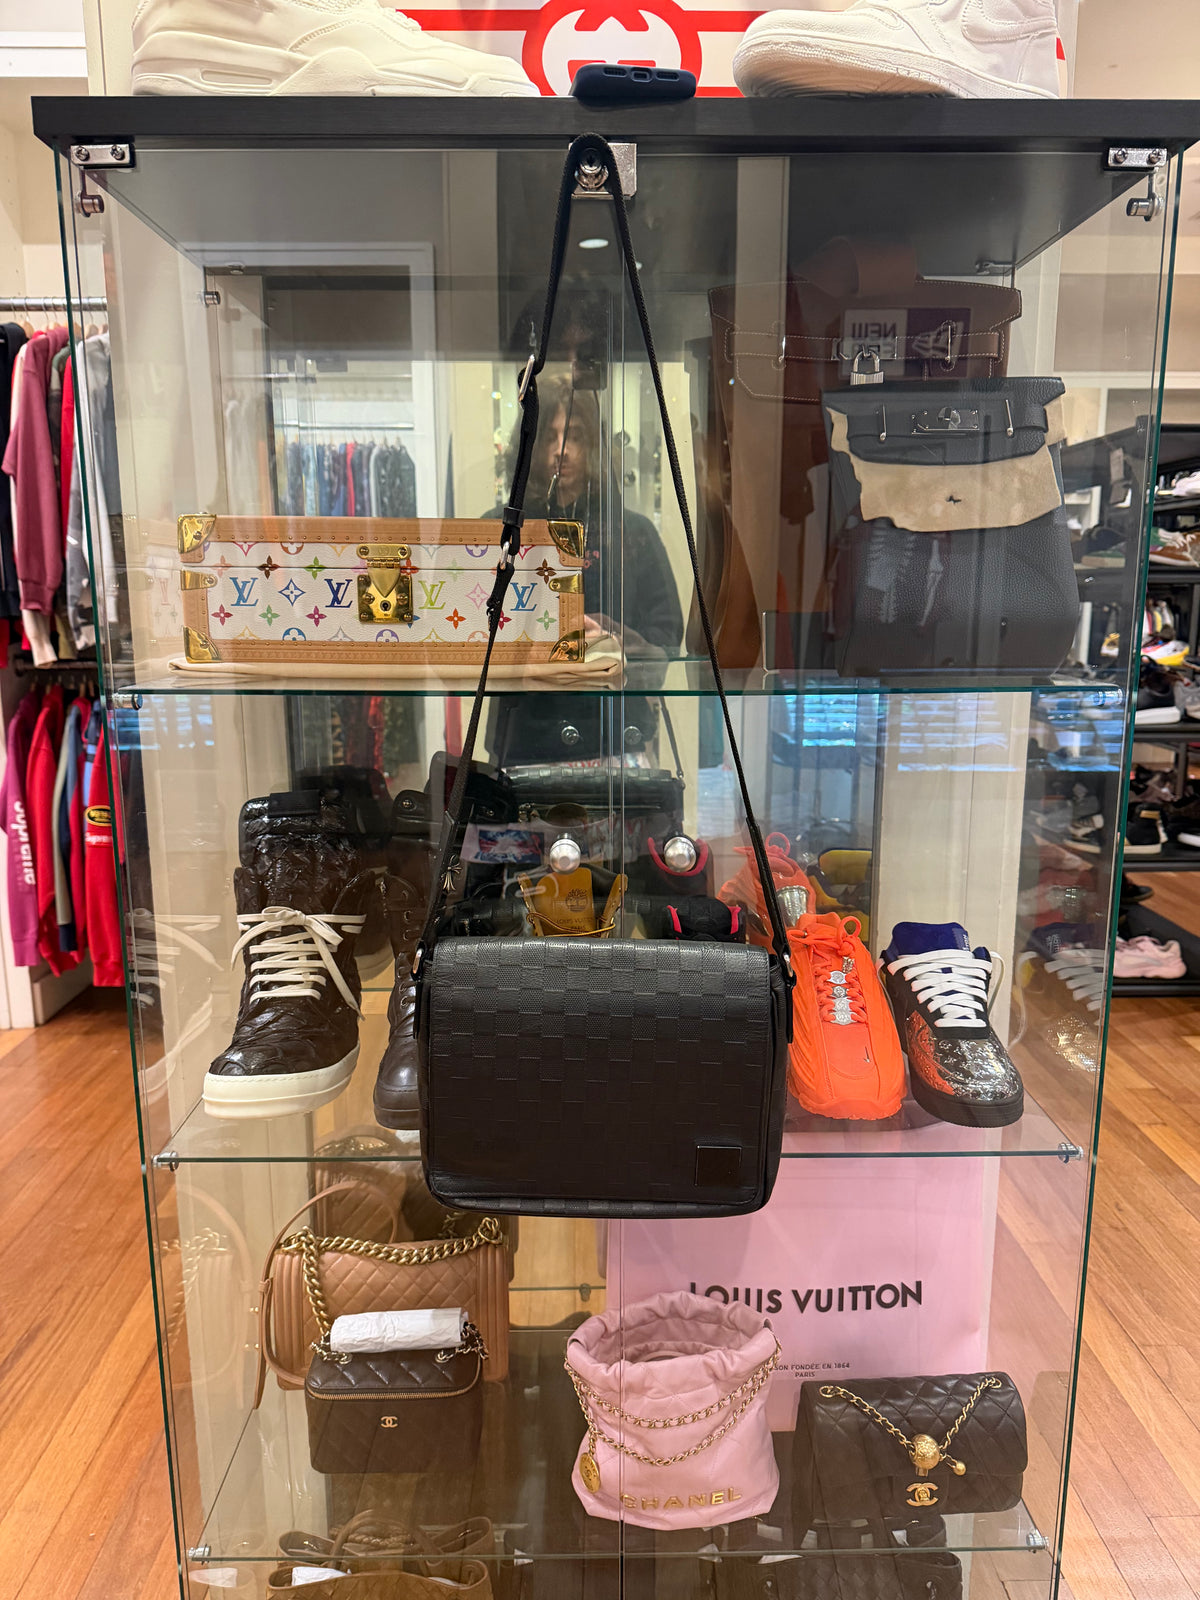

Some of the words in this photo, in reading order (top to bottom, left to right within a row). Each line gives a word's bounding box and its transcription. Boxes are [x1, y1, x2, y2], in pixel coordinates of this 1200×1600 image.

[792, 1280, 922, 1314] VUITTON
[791, 1362, 820, 1371] FONDÉE
[620, 1487, 742, 1510] CHANEL
